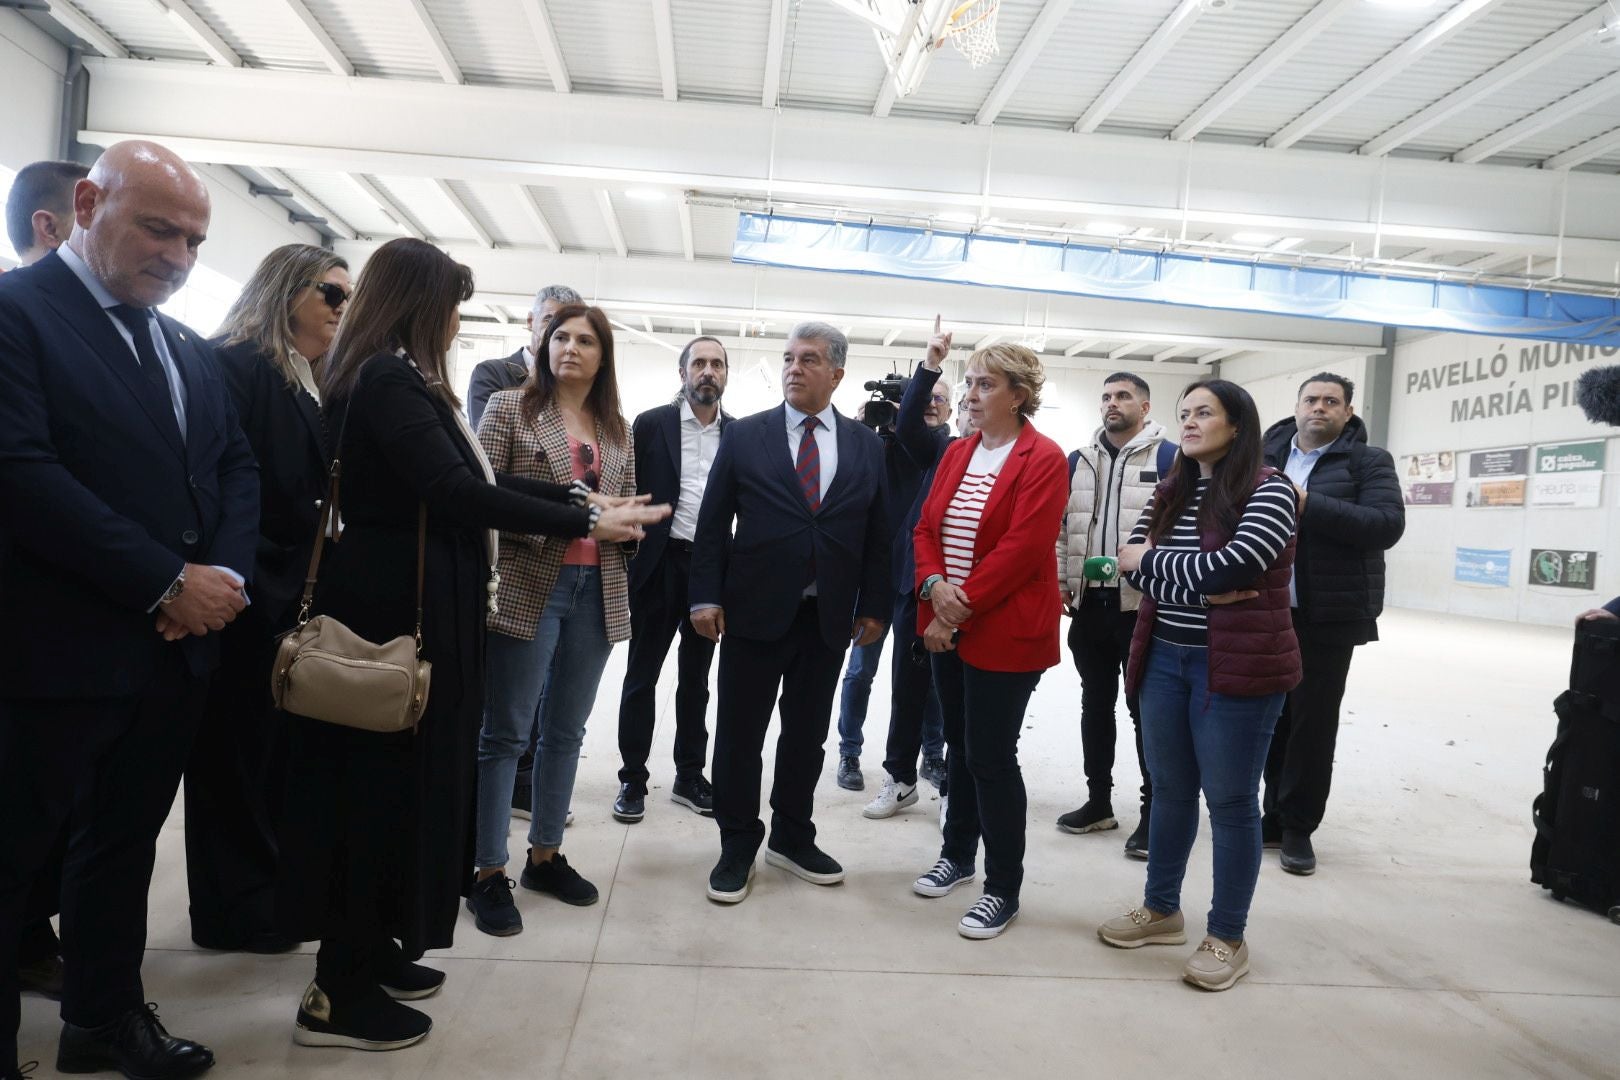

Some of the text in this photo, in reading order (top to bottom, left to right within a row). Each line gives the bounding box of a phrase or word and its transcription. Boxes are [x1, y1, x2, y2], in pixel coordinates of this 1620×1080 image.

[1406, 344, 1508, 394] PAVELLÓ
[1450, 380, 1578, 423] MARÍA PI
